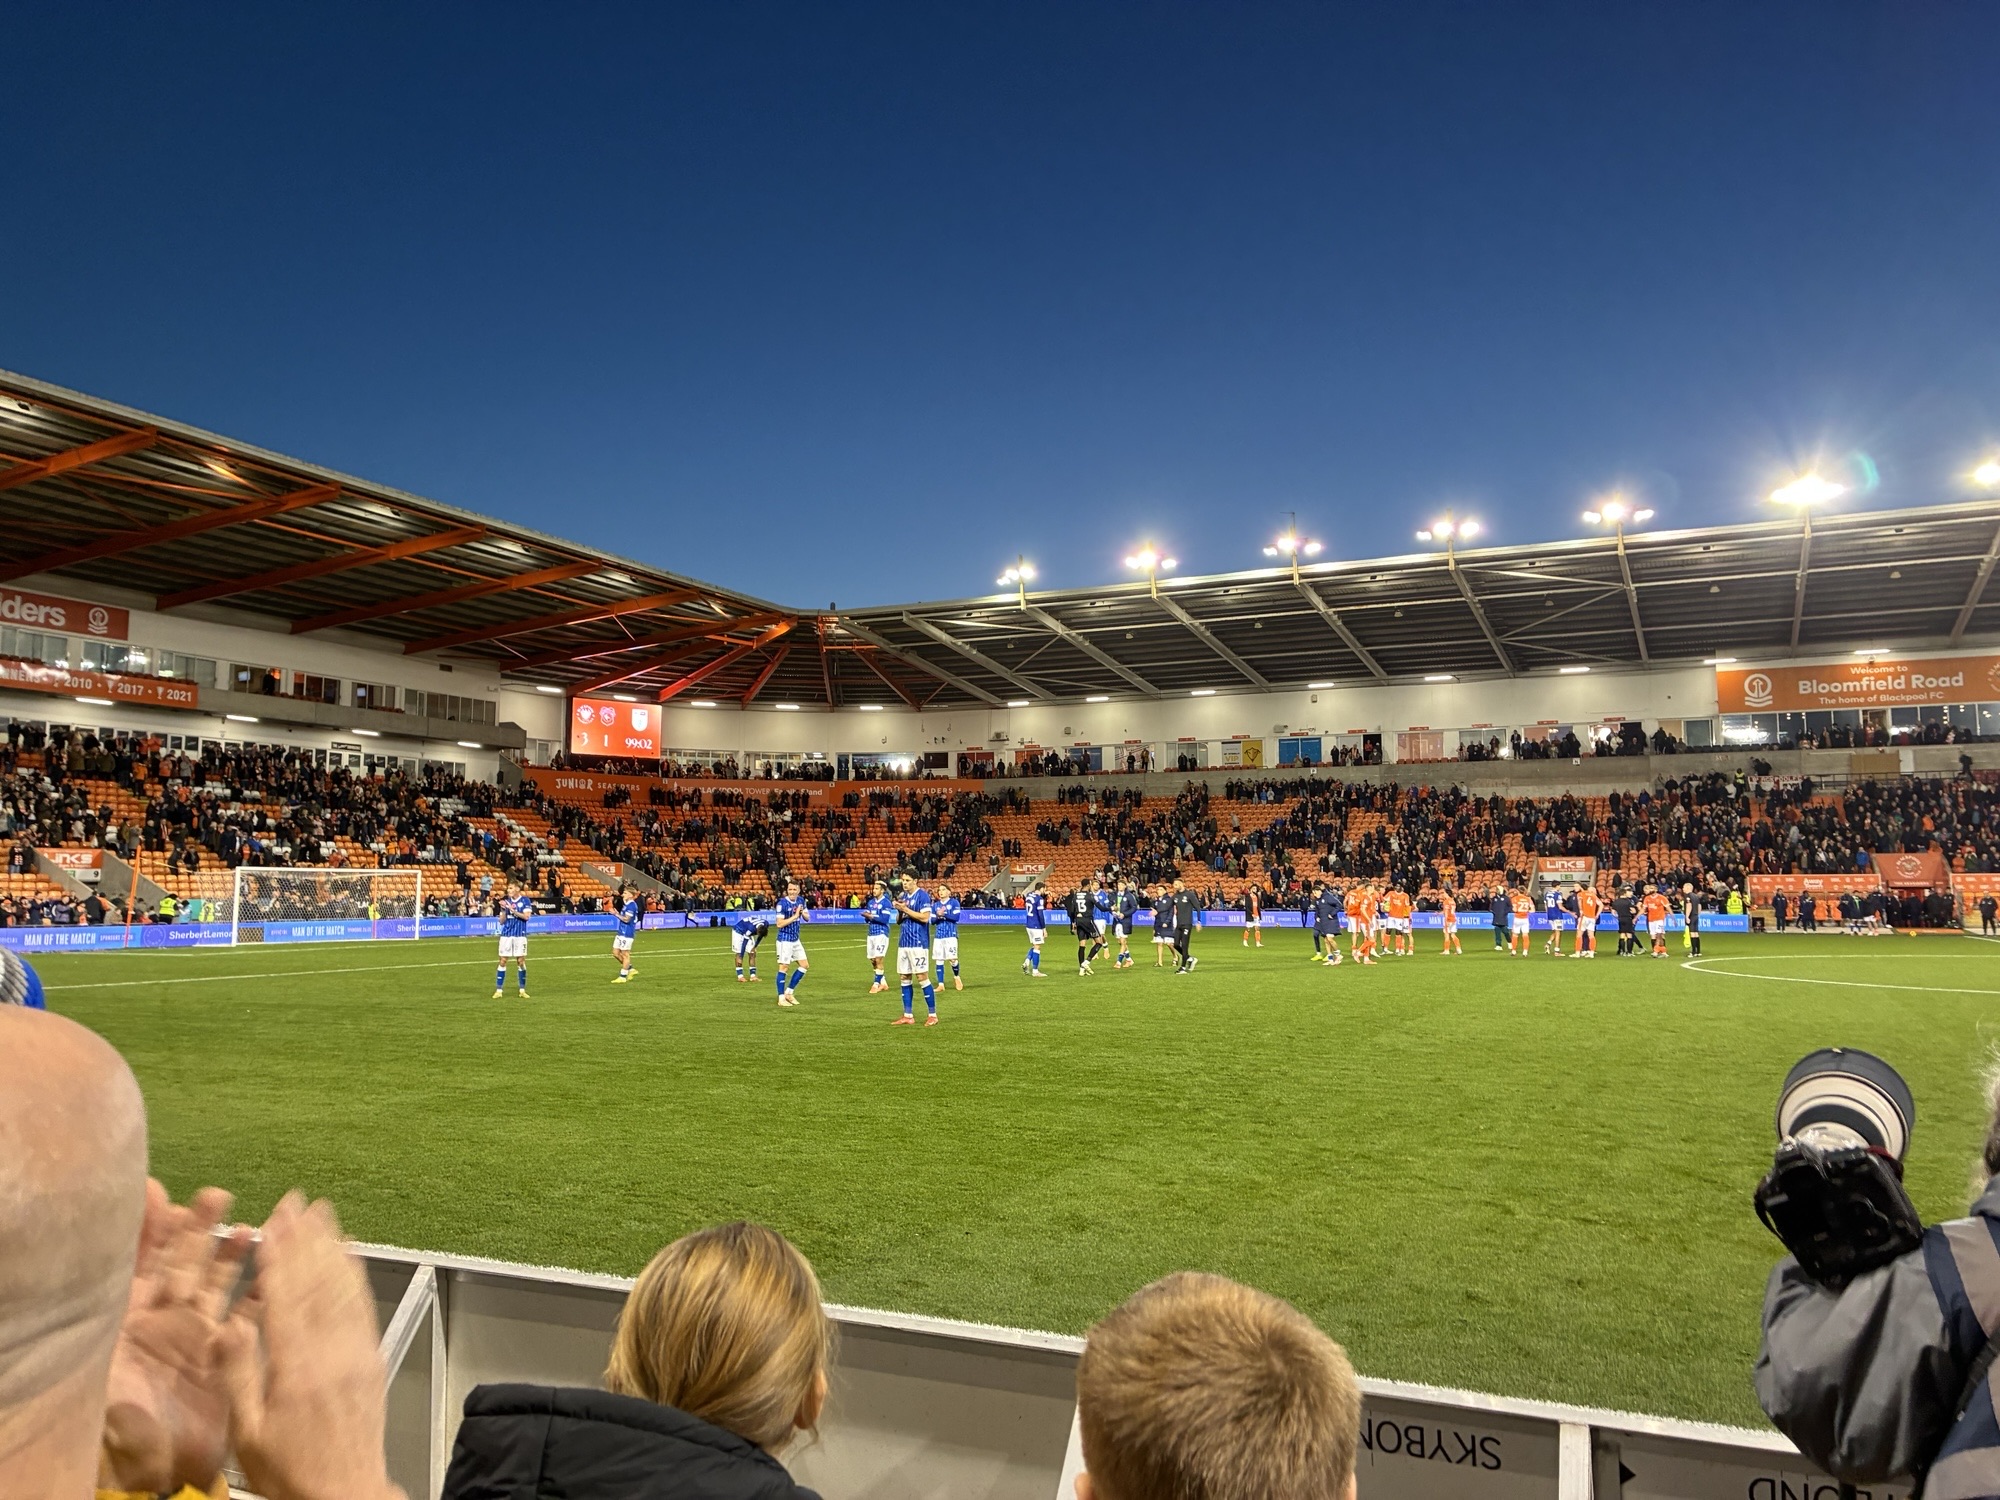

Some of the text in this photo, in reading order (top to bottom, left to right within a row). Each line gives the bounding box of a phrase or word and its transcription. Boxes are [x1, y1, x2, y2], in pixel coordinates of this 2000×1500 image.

[1850, 665, 1895, 675] Welcome
[1798, 671, 1964, 695] Bloomfield Road
[63, 677, 92, 690] 2010
[117, 684, 144, 697] 2017
[166, 690, 192, 702] 2021
[1819, 697, 1836, 705] The
[1838, 695, 1865, 704] home
[1867, 694, 1878, 702] of
[1930, 691, 1945, 700] FC
[581, 732, 653, 750] 3 1 99:02
[555, 778, 641, 792] JUNIOR SEASDERS
[905, 787, 954, 795] SASIDERS
[1016, 864, 1045, 872] LINKS
[1546, 860, 1586, 869] LINKS
[93, 870, 99, 878] 9
[1076, 899, 1087, 913] 13
[1517, 901, 1529, 912] 23
[1586, 896, 1594, 906] 4
[1261, 915, 1275, 923] ATCH
[1428, 916, 1441, 925] MAN
[1461, 916, 1480, 925] MATCH
[291, 926, 305, 937] MAN
[306, 926, 314, 936] OF
[315, 926, 325, 936] THE
[326, 925, 345, 936] MATCH
[396, 922, 462, 933] SherbrtLemon.co.uk
[24, 933, 42, 946] MAN
[43, 933, 54, 945] OF
[55, 933, 68, 945] THE
[71, 932, 96, 945] MATCH
[915, 956, 927, 967] 22
